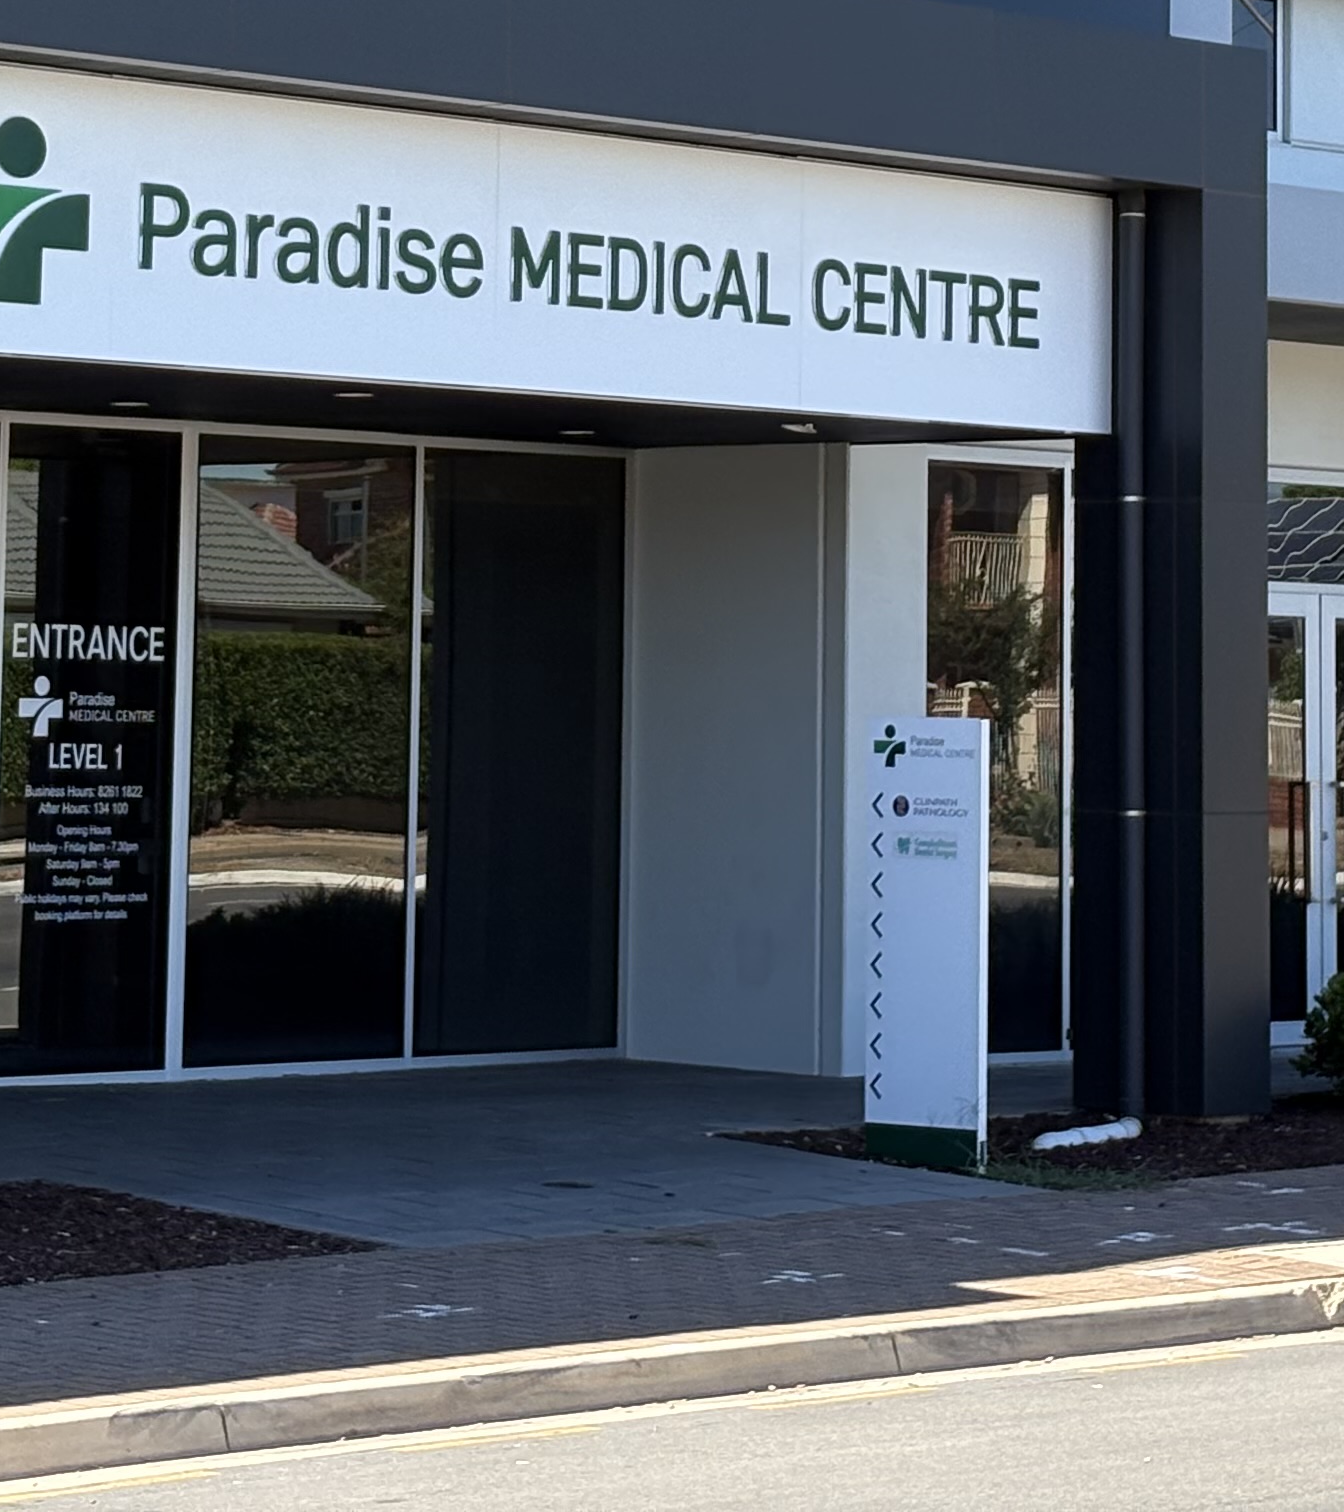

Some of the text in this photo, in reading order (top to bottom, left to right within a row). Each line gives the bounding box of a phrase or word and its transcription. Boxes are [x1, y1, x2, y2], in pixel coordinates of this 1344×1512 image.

[138, 181, 1042, 351] Paradise MEDICAL CENTRE
[12, 621, 166, 662] ENTRANCE
[69, 691, 116, 707] Paradise
[69, 709, 156, 723] MEDICAL CENTRE
[910, 735, 945, 747] Paradise
[48, 743, 123, 770] LEVEL 1
[910, 748, 976, 760] MEDICAL CENTRE
[24, 784, 66, 798] Business
[913, 807, 969, 818] PATHOLOGY
[56, 824, 89, 838] Opening
[28, 842, 58, 855] Monday
[64, 841, 88, 854] Friday
[52, 875, 81, 888] Sunday
[86, 875, 114, 887] Closed
